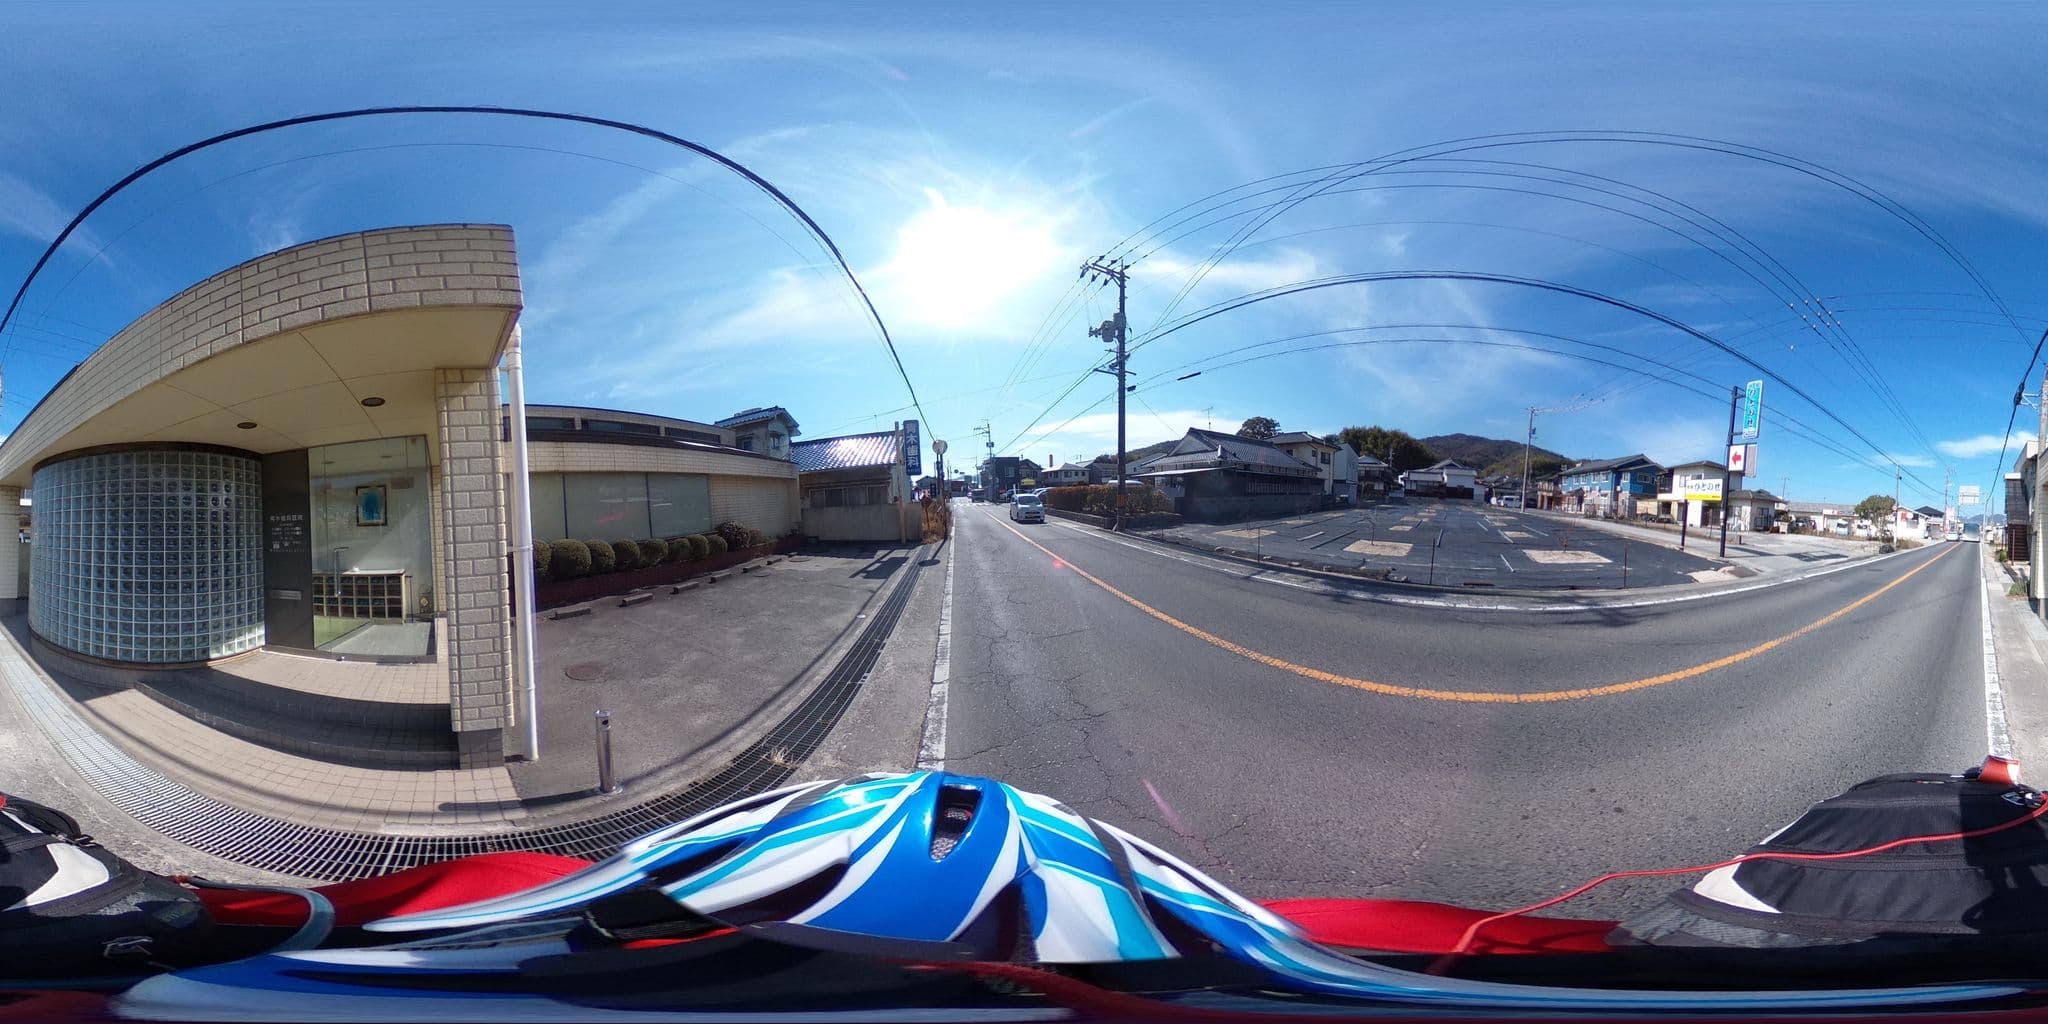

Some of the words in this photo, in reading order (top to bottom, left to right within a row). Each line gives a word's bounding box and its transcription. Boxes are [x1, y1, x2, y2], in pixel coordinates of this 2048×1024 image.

[1747, 389, 1757, 428] ひとのせ
[1694, 482, 1720, 491] ひとのせ
